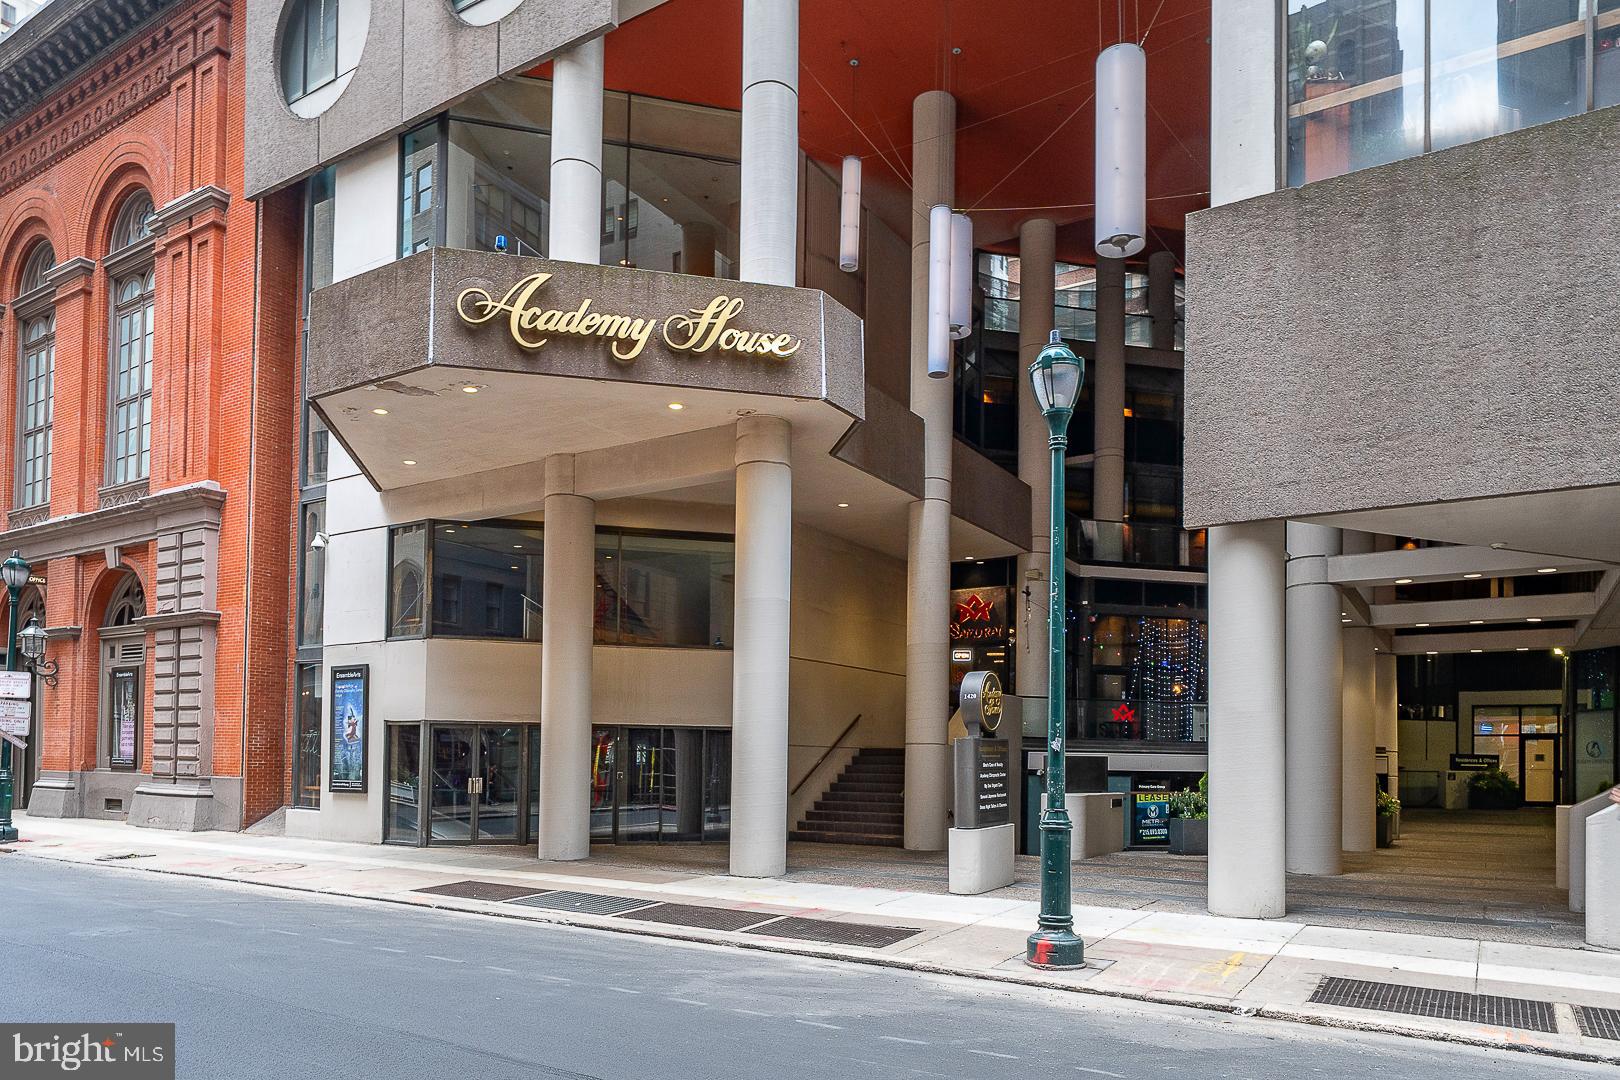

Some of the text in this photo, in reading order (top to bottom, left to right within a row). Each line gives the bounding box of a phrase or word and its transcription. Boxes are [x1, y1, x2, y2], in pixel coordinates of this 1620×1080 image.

[456, 272, 801, 361] Academy House
[1138, 793, 1168, 802] LEASE
